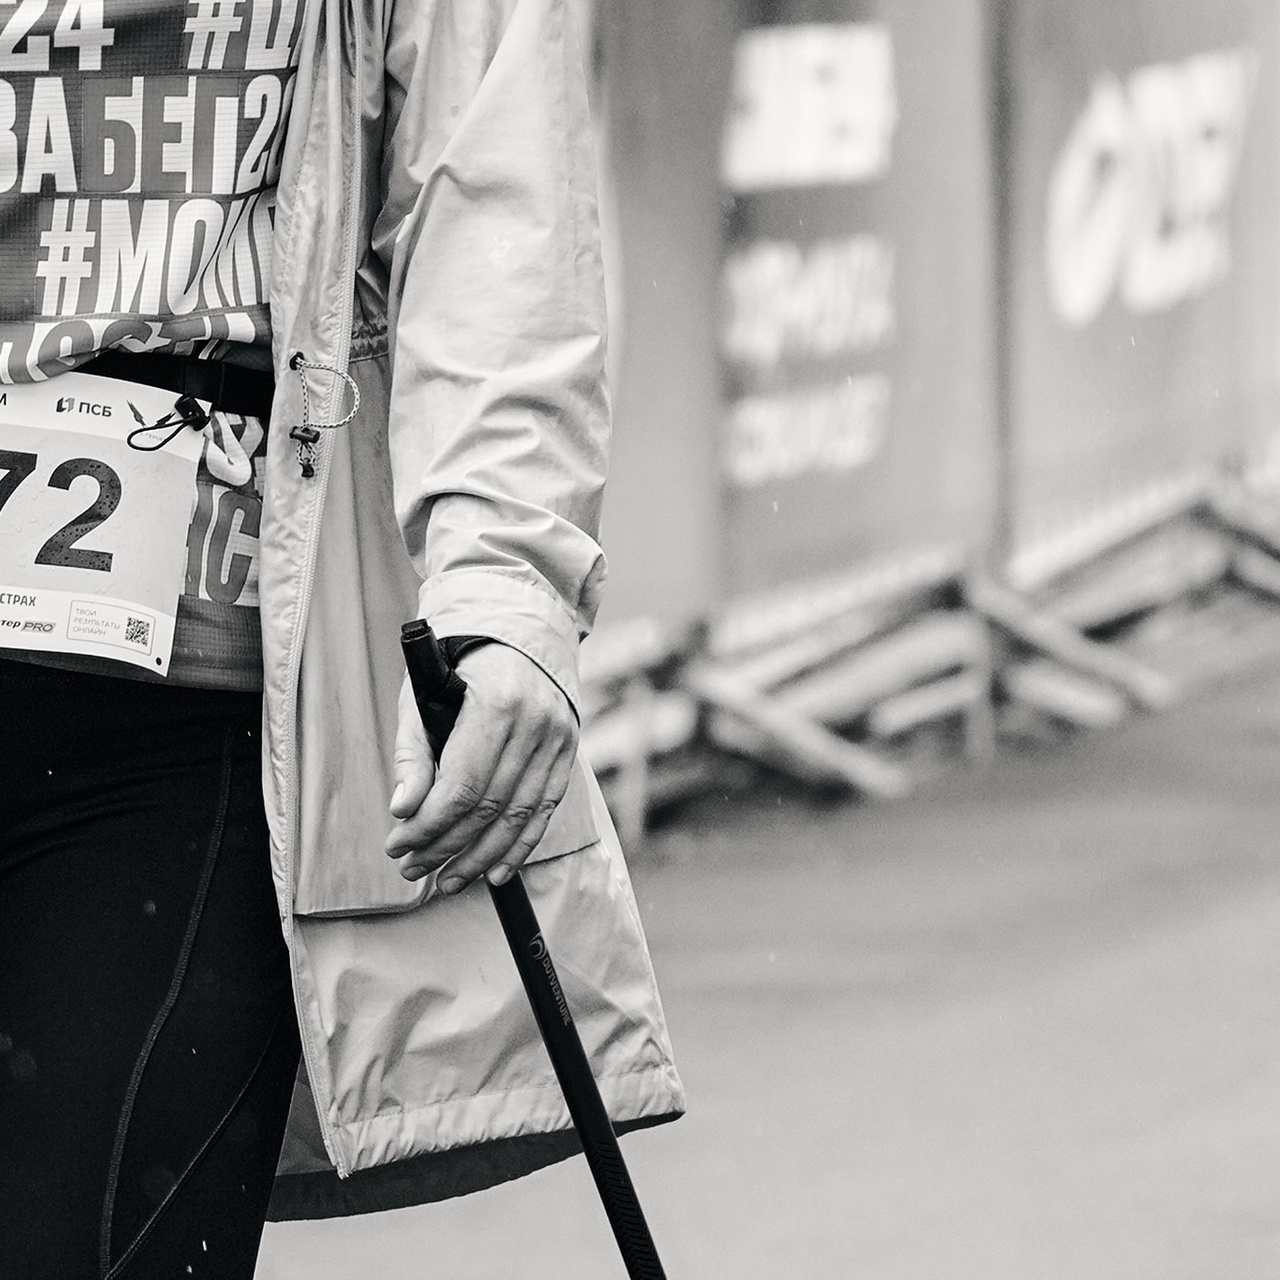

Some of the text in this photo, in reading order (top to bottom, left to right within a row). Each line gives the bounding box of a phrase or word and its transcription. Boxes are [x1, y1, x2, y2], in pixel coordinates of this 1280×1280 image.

[78, 401, 113, 418] ПСБ
[22, 621, 56, 634] PRO
[541, 956, 571, 1027] OUTVENTURE
